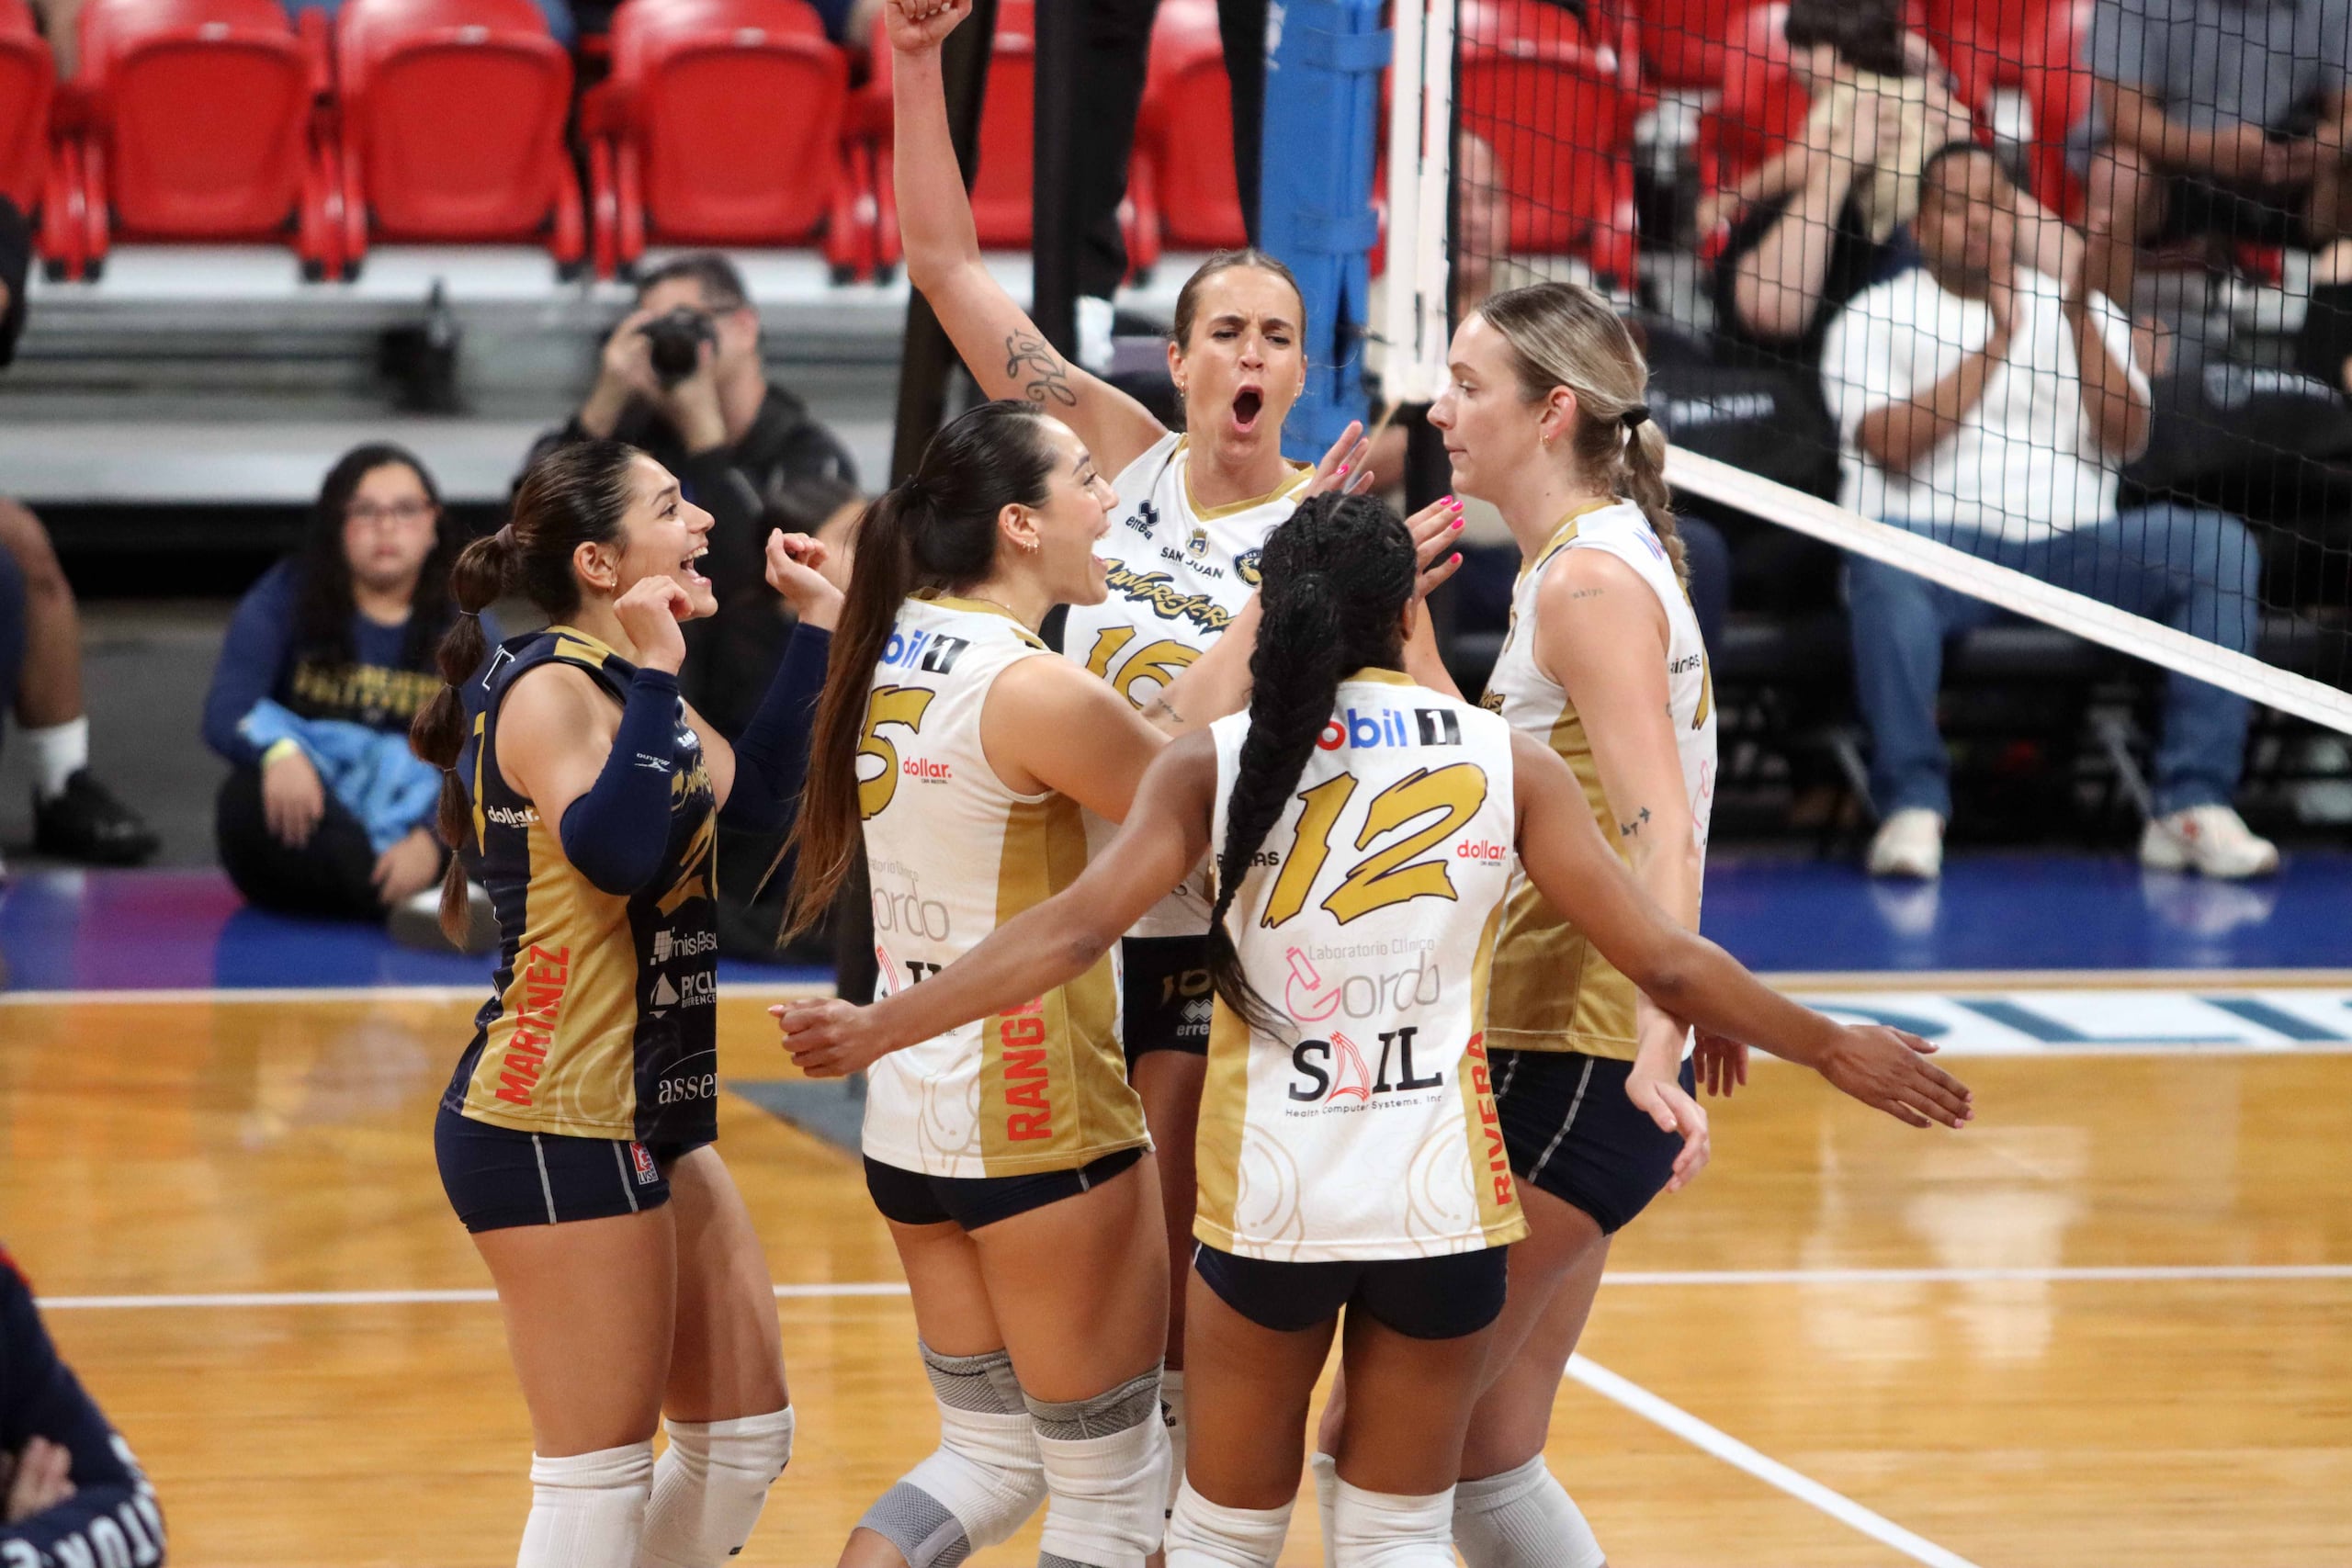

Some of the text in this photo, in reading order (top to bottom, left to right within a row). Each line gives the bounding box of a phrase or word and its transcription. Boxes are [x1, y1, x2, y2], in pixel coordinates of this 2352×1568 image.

[1160, 547, 1225, 579] SAN JUAN
[879, 622, 931, 669] bil
[1317, 708, 1408, 750] obil
[903, 757, 953, 778] dollar.
[488, 805, 540, 824] dollar.
[1216, 851, 1280, 867] RAS
[1261, 761, 1488, 929] 12
[874, 877, 950, 942] ordo
[1308, 941, 1388, 961] Laboratorio
[1177, 1023, 1210, 1036] erre
[658, 1072, 718, 1104] asse
[1285, 1109, 1319, 1118] Health
[1322, 1103, 1369, 1115] Computer
[1466, 1031, 1513, 1205] RIVERA
